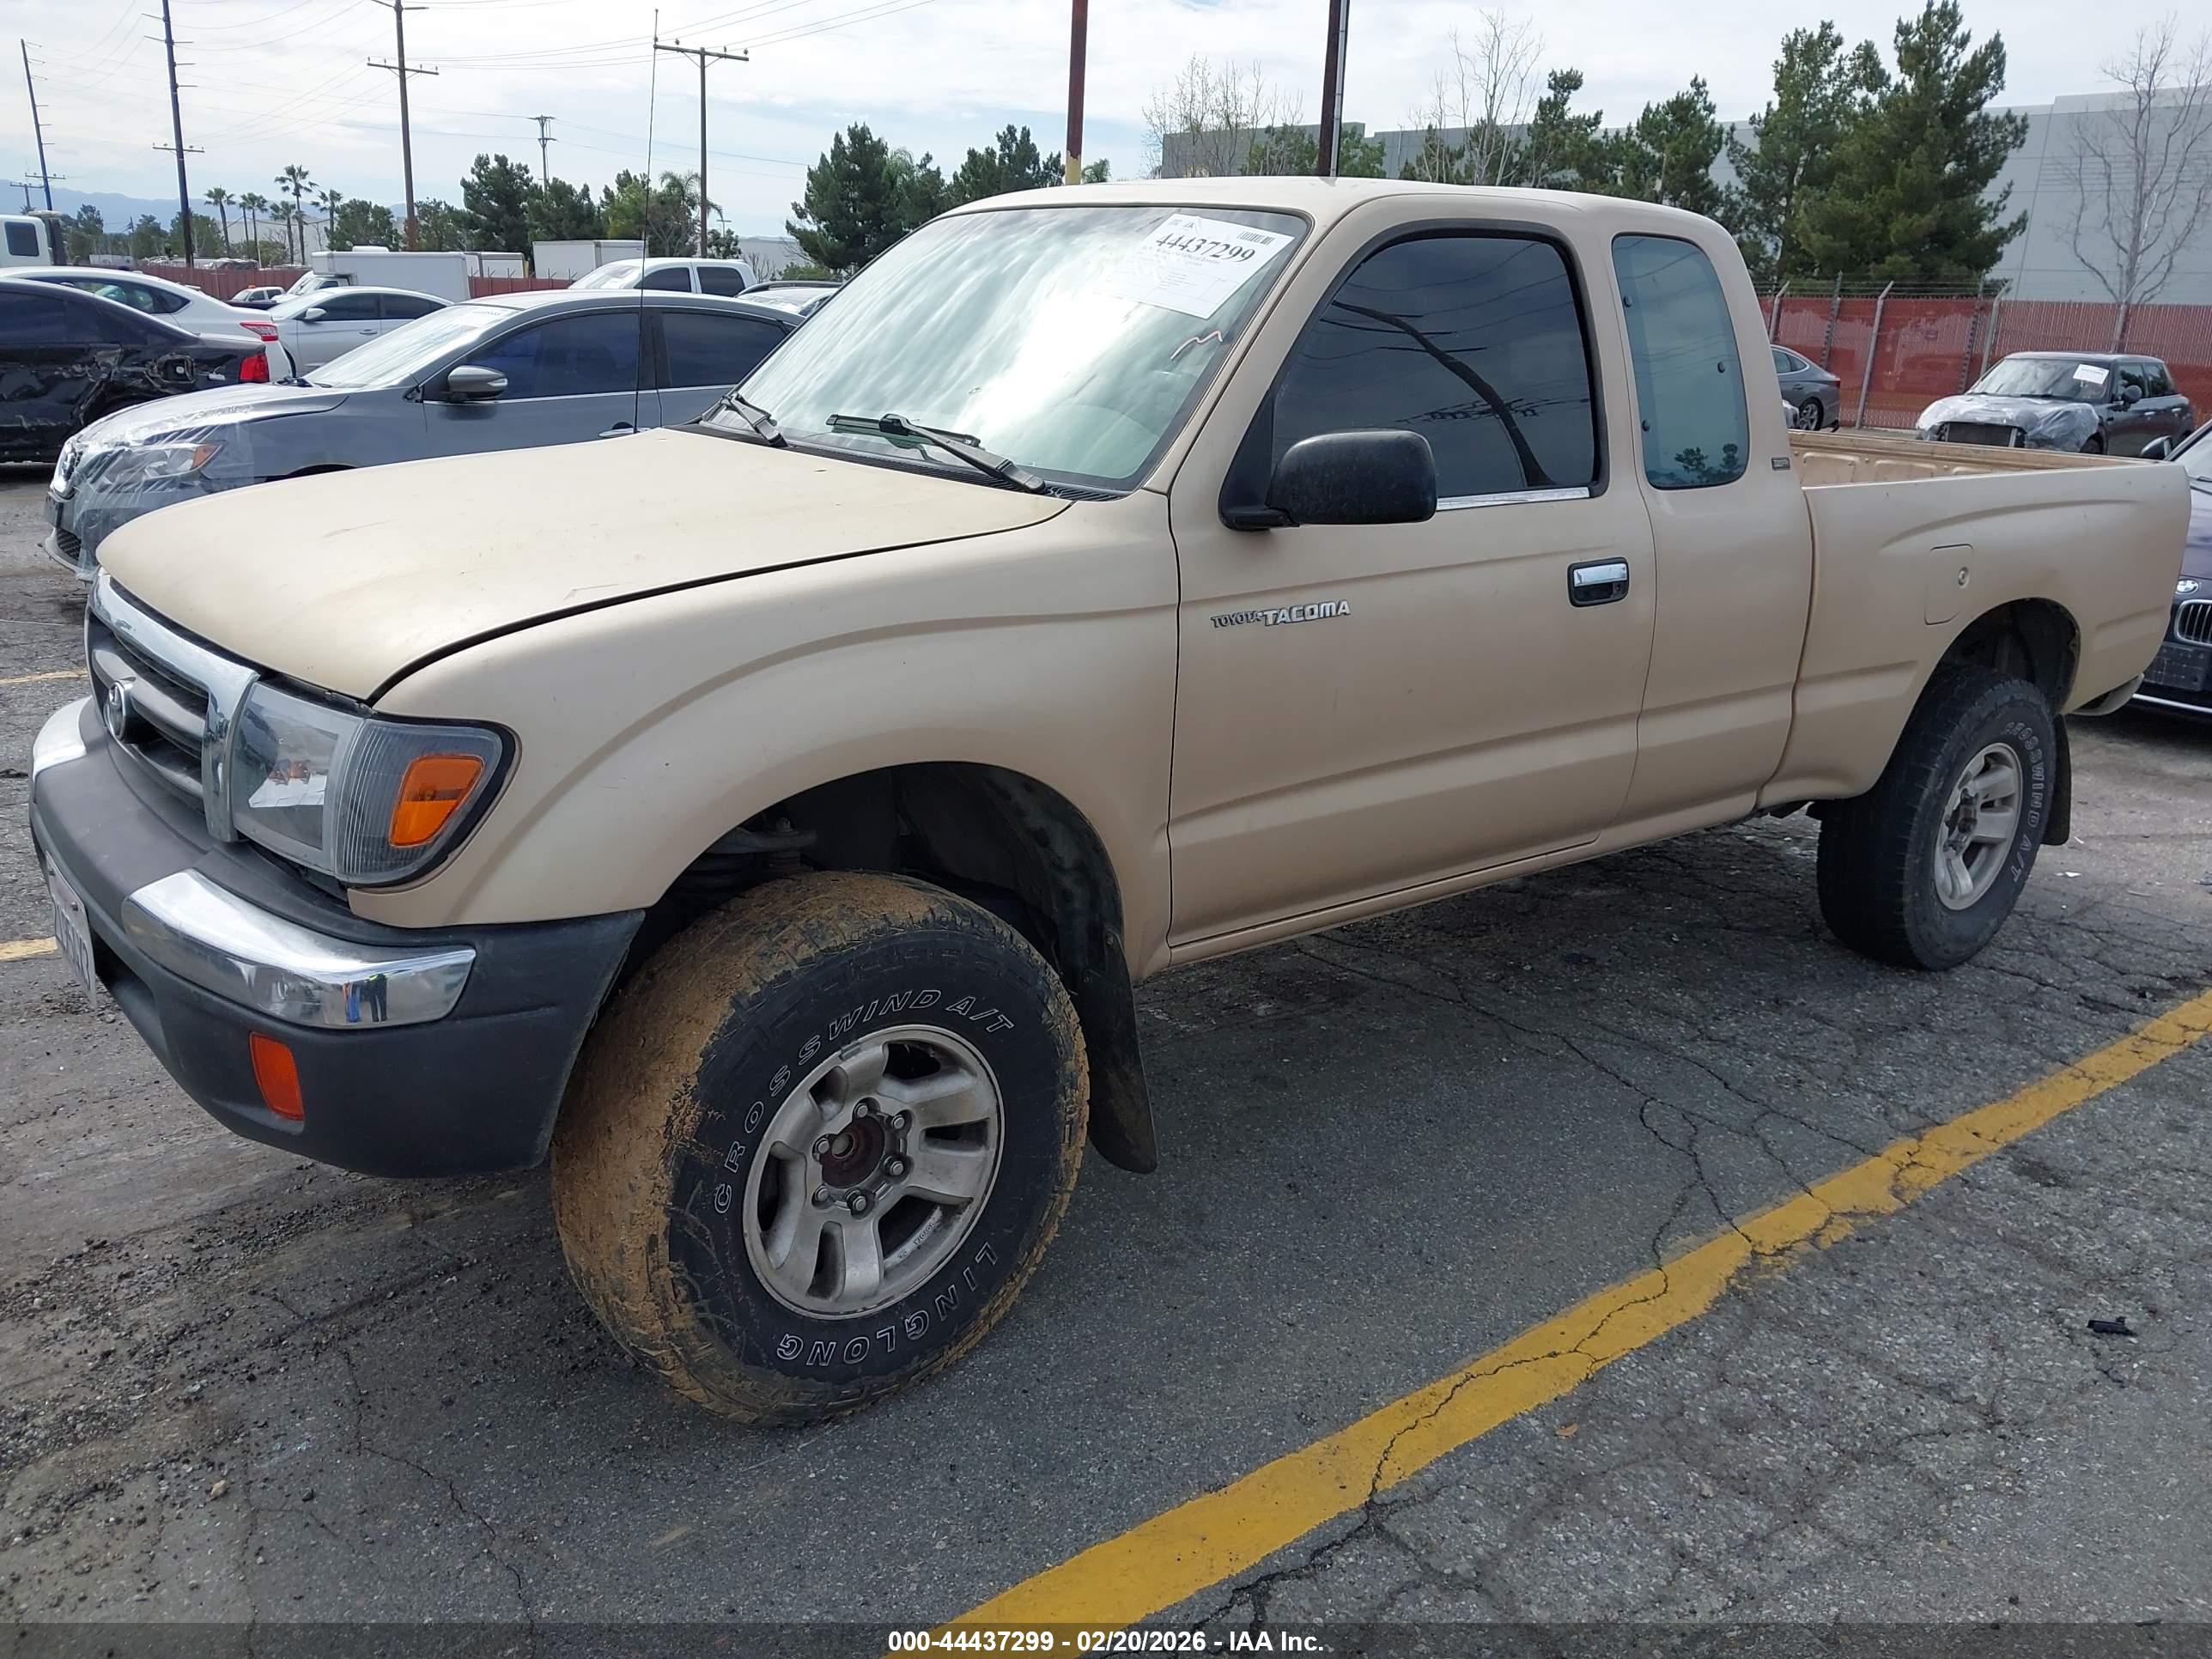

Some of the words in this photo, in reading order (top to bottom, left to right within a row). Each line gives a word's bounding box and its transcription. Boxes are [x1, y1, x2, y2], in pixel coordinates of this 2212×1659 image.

[1156, 233, 1255, 262] 44437299
[1210, 611, 1263, 629] TOYOTA
[1263, 599, 1352, 627] TACOMA
[714, 989, 942, 1214] CROSSWIND
[946, 995, 1015, 1034] A/T
[776, 1243, 998, 1367] LINGLONG
